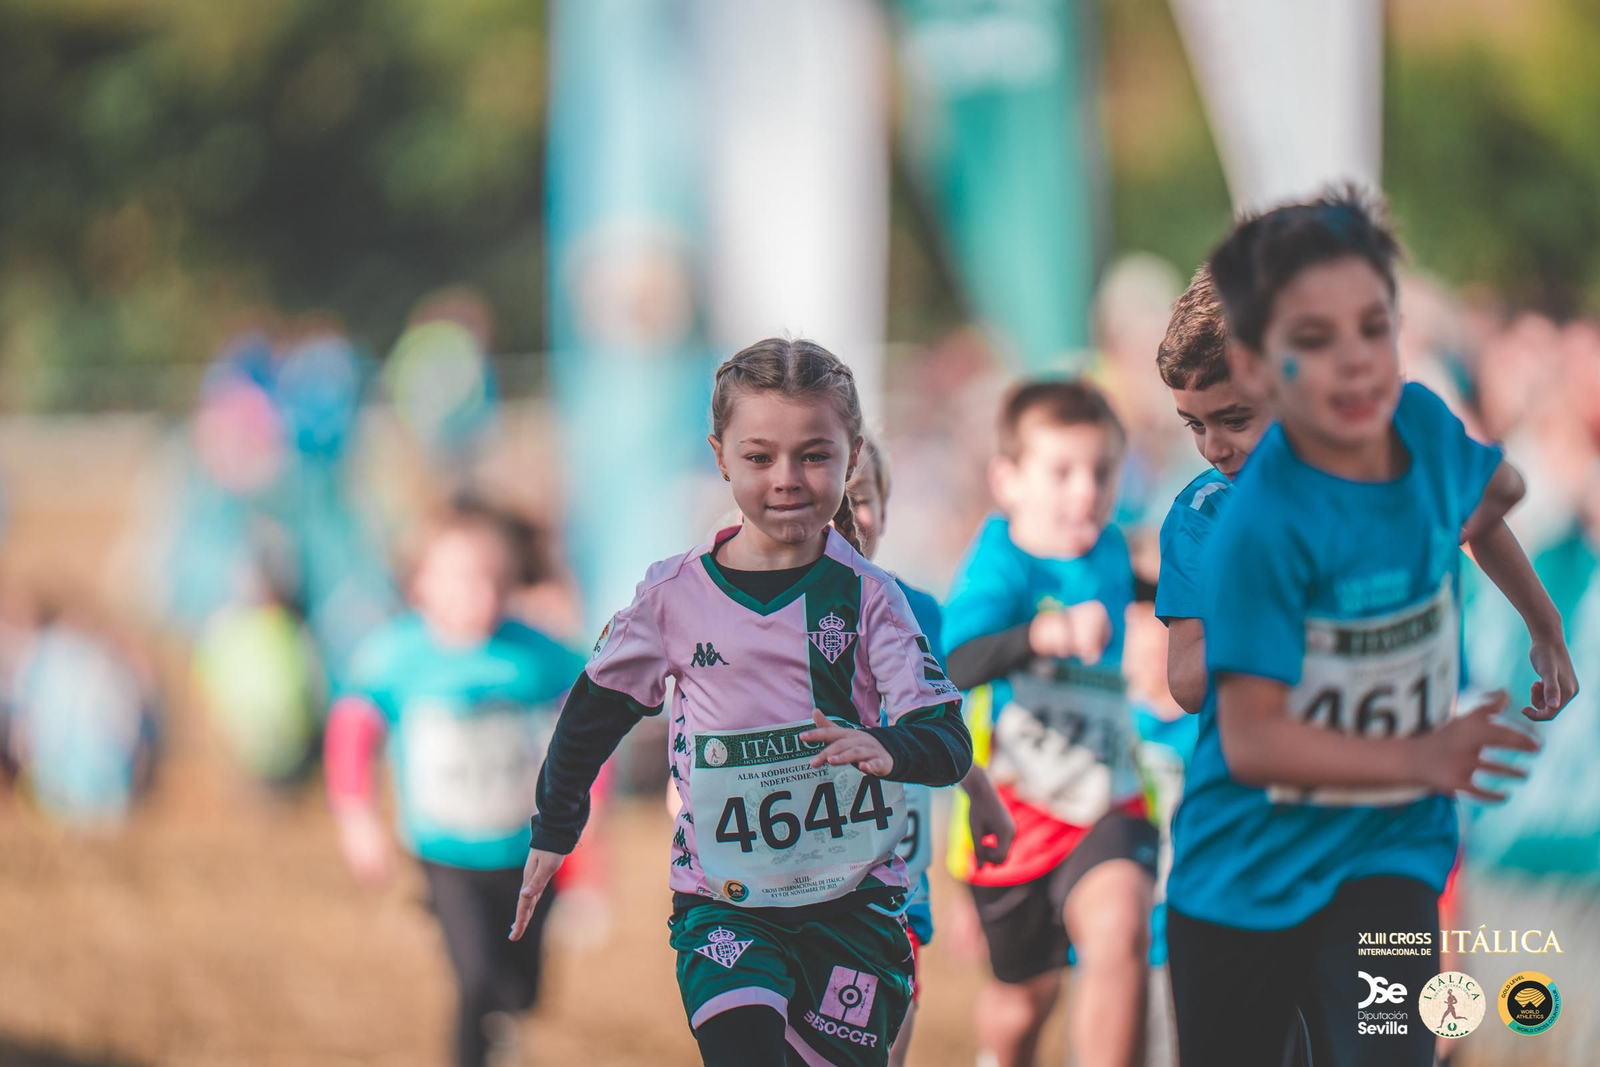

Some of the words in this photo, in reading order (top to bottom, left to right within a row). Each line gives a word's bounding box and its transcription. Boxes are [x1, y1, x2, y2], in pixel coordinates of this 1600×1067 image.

[741, 733, 825, 759] ITÁLIC
[738, 771, 760, 781] ALBA
[761, 763, 812, 779] RODRIGUEZ
[760, 768, 829, 788] INDEPENDIENTE
[715, 775, 894, 853] 4644
[778, 882, 817, 892] INTERNACIONAL
[790, 887, 819, 896] NOVIEMBRE
[804, 1010, 877, 1048] BESOCCER
